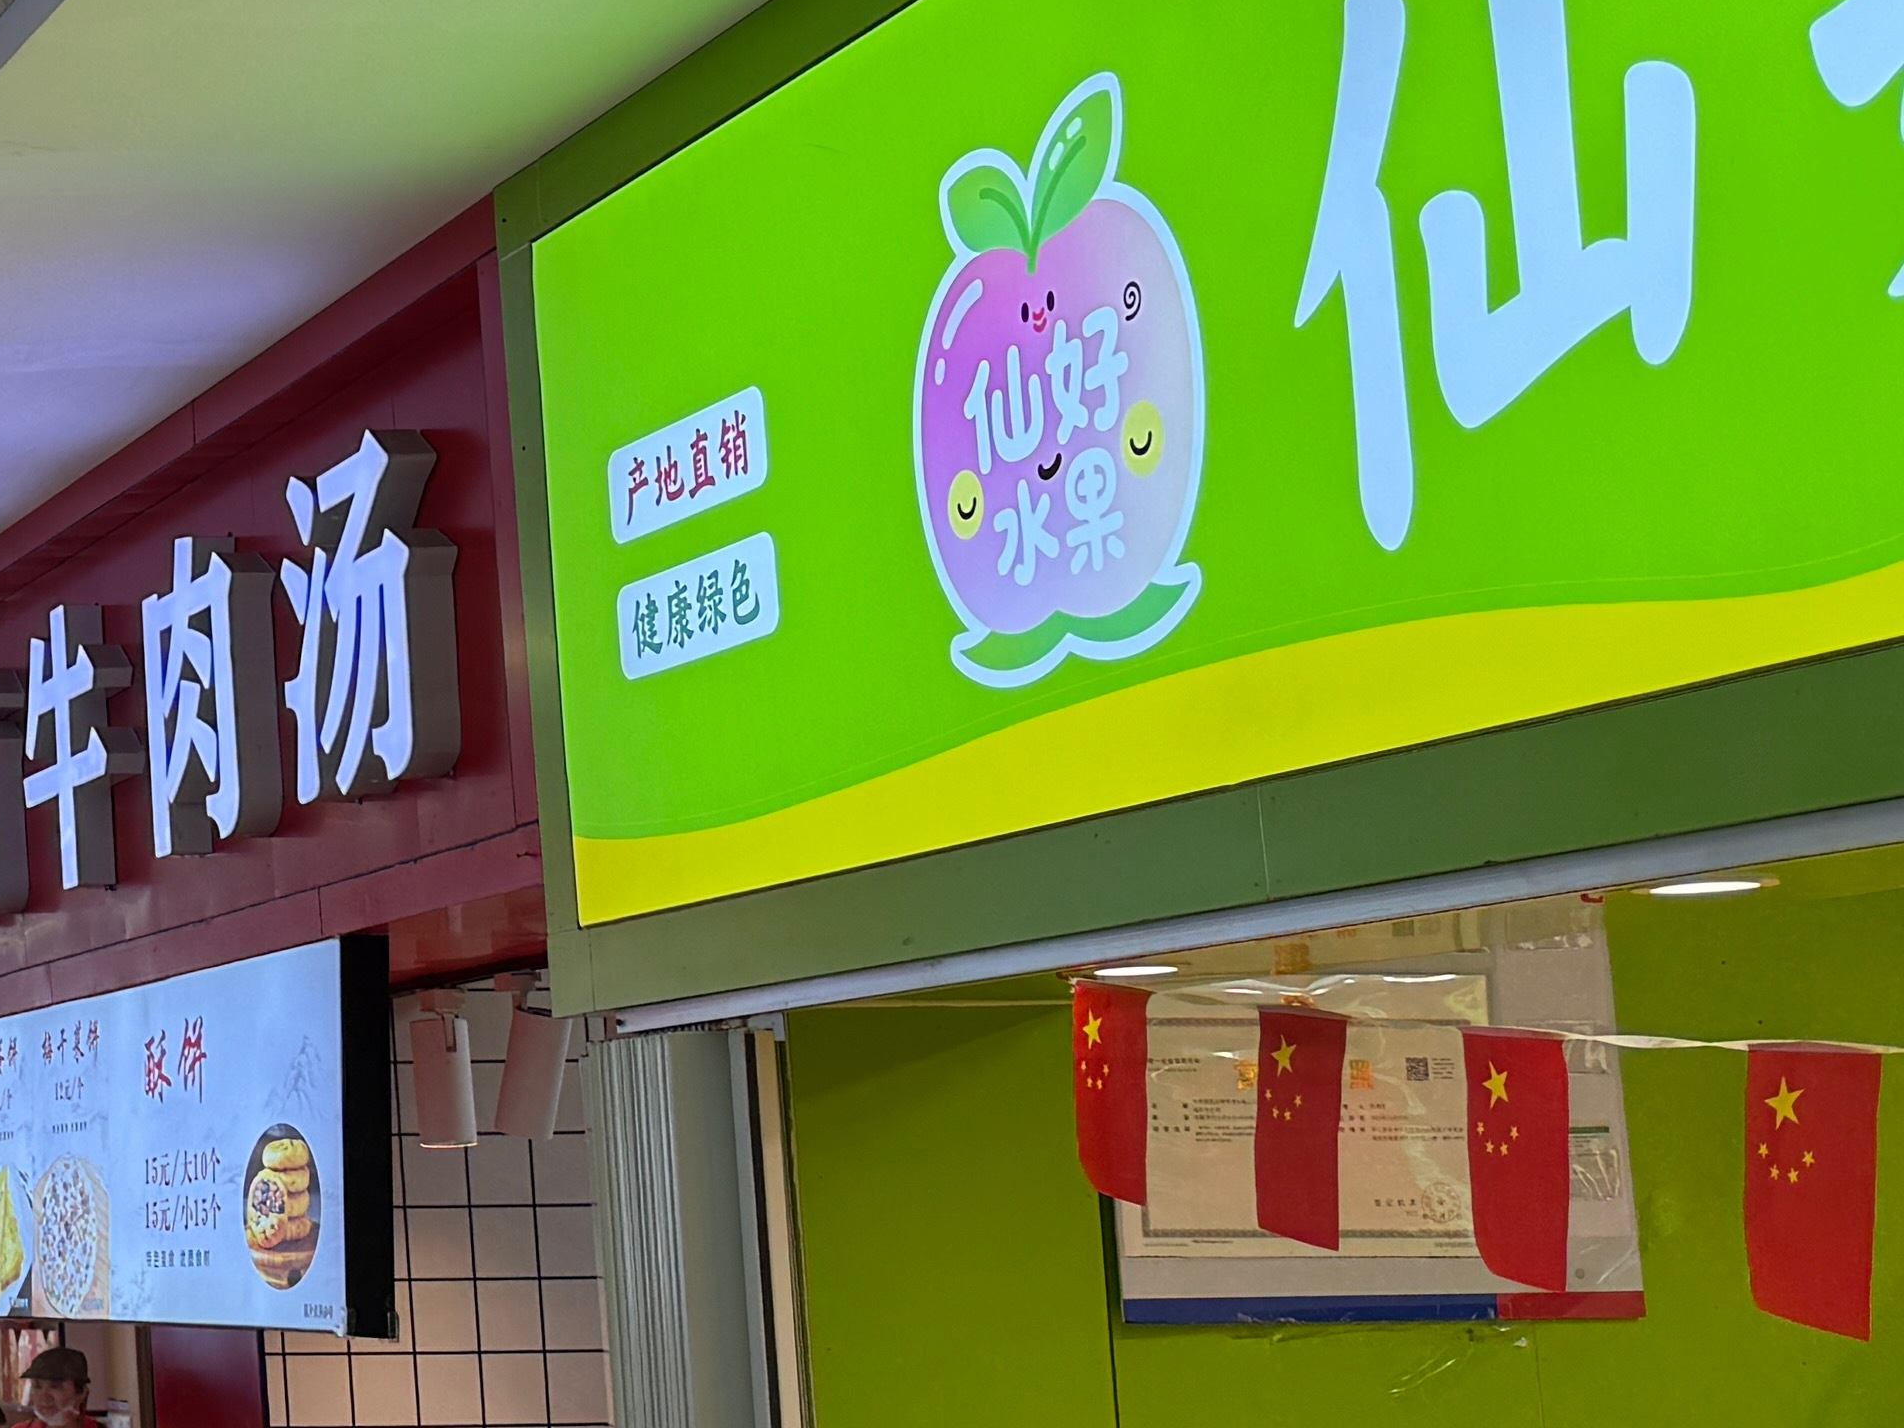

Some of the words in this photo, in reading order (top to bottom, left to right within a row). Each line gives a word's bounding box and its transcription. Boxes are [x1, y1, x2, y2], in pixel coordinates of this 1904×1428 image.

[963, 305, 1129, 474] 仙好
[624, 411, 751, 528] 产地直销
[994, 456, 1126, 586] 水果
[630, 557, 762, 662] 健康绿色
[143, 1015, 208, 1104] 酥饼
[144, 1147, 221, 1188] 15元/大10个
[144, 1193, 222, 1233] 15元/小15个
